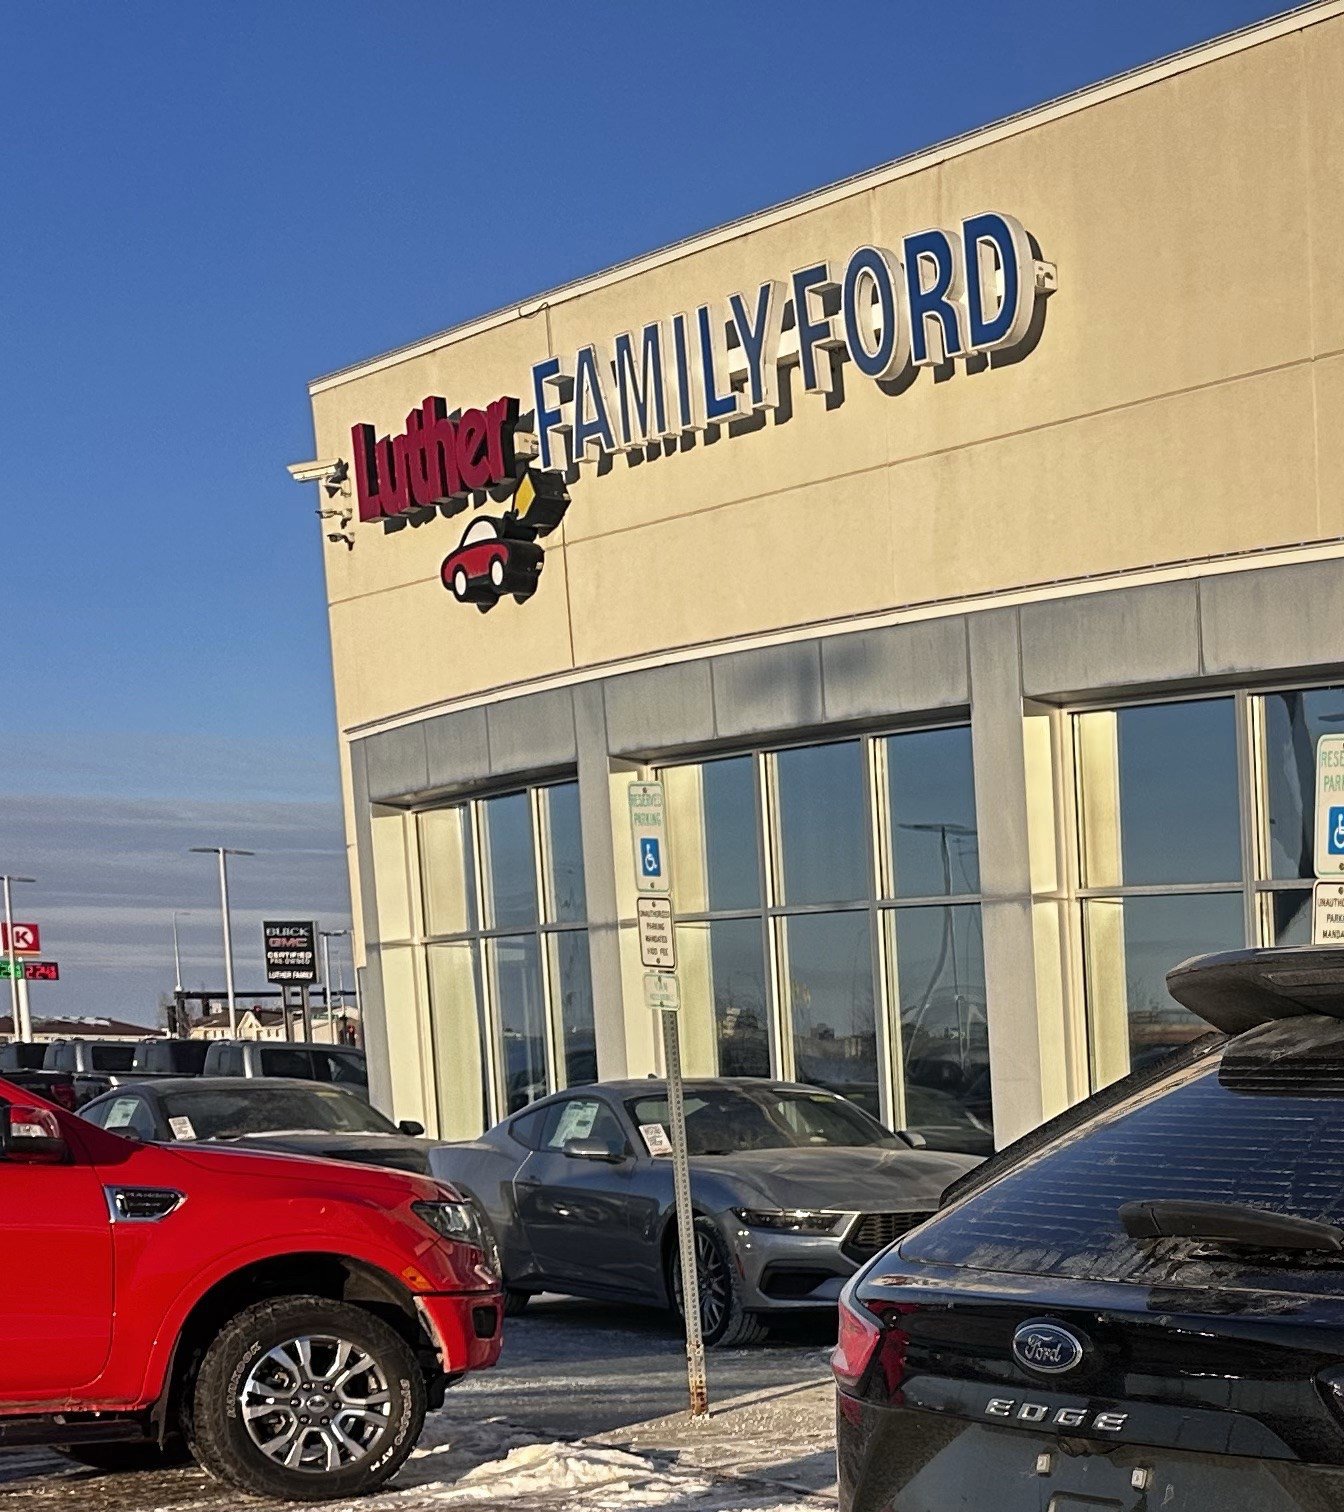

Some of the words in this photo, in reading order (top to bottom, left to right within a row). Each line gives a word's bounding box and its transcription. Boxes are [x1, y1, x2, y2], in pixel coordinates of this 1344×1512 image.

[351, 395, 514, 522] Luther
[531, 281, 780, 471] FAMILY
[791, 211, 1030, 394] FORD
[15, 930, 31, 945] K
[266, 927, 310, 936] BUICK
[269, 937, 308, 947] GMC
[1024, 1333, 1063, 1363] Ford
[984, 1397, 1130, 1432] EDGE
